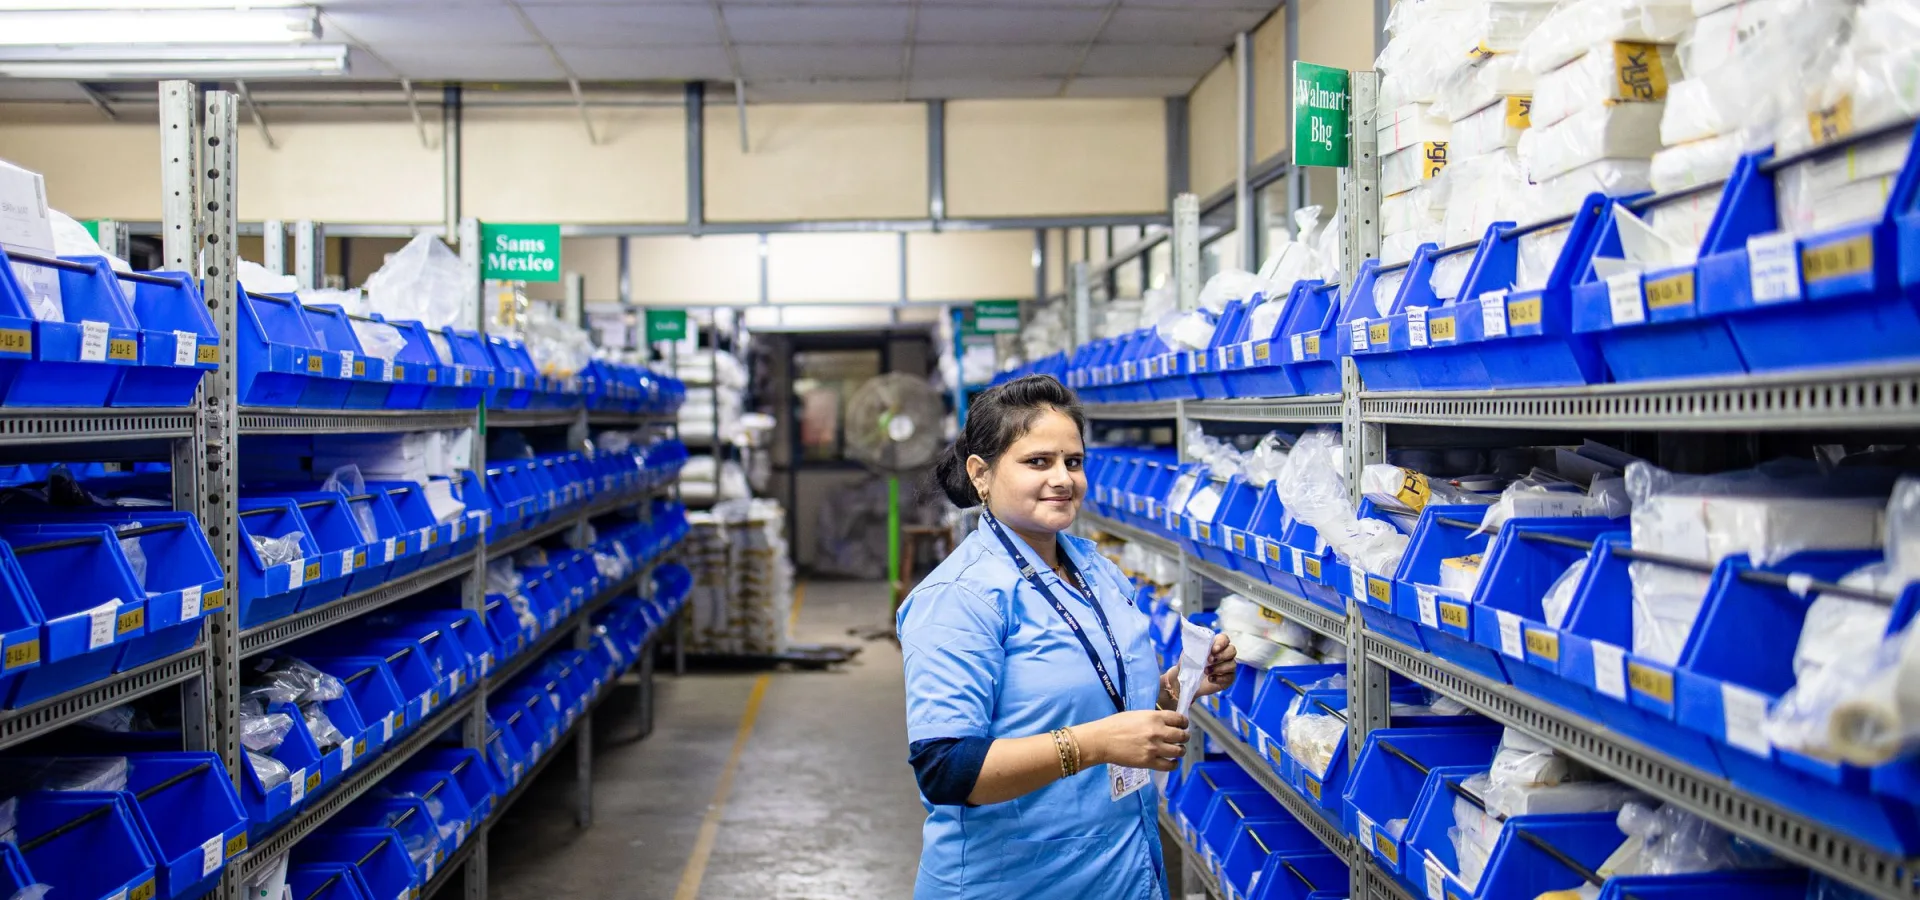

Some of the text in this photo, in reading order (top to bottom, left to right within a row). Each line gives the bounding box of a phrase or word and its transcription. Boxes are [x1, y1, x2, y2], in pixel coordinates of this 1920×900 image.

[1298, 79, 1346, 111] Walmart
[1310, 116, 1333, 151] Bhg
[496, 234, 546, 253] Sams
[488, 253, 555, 271] Mexico
